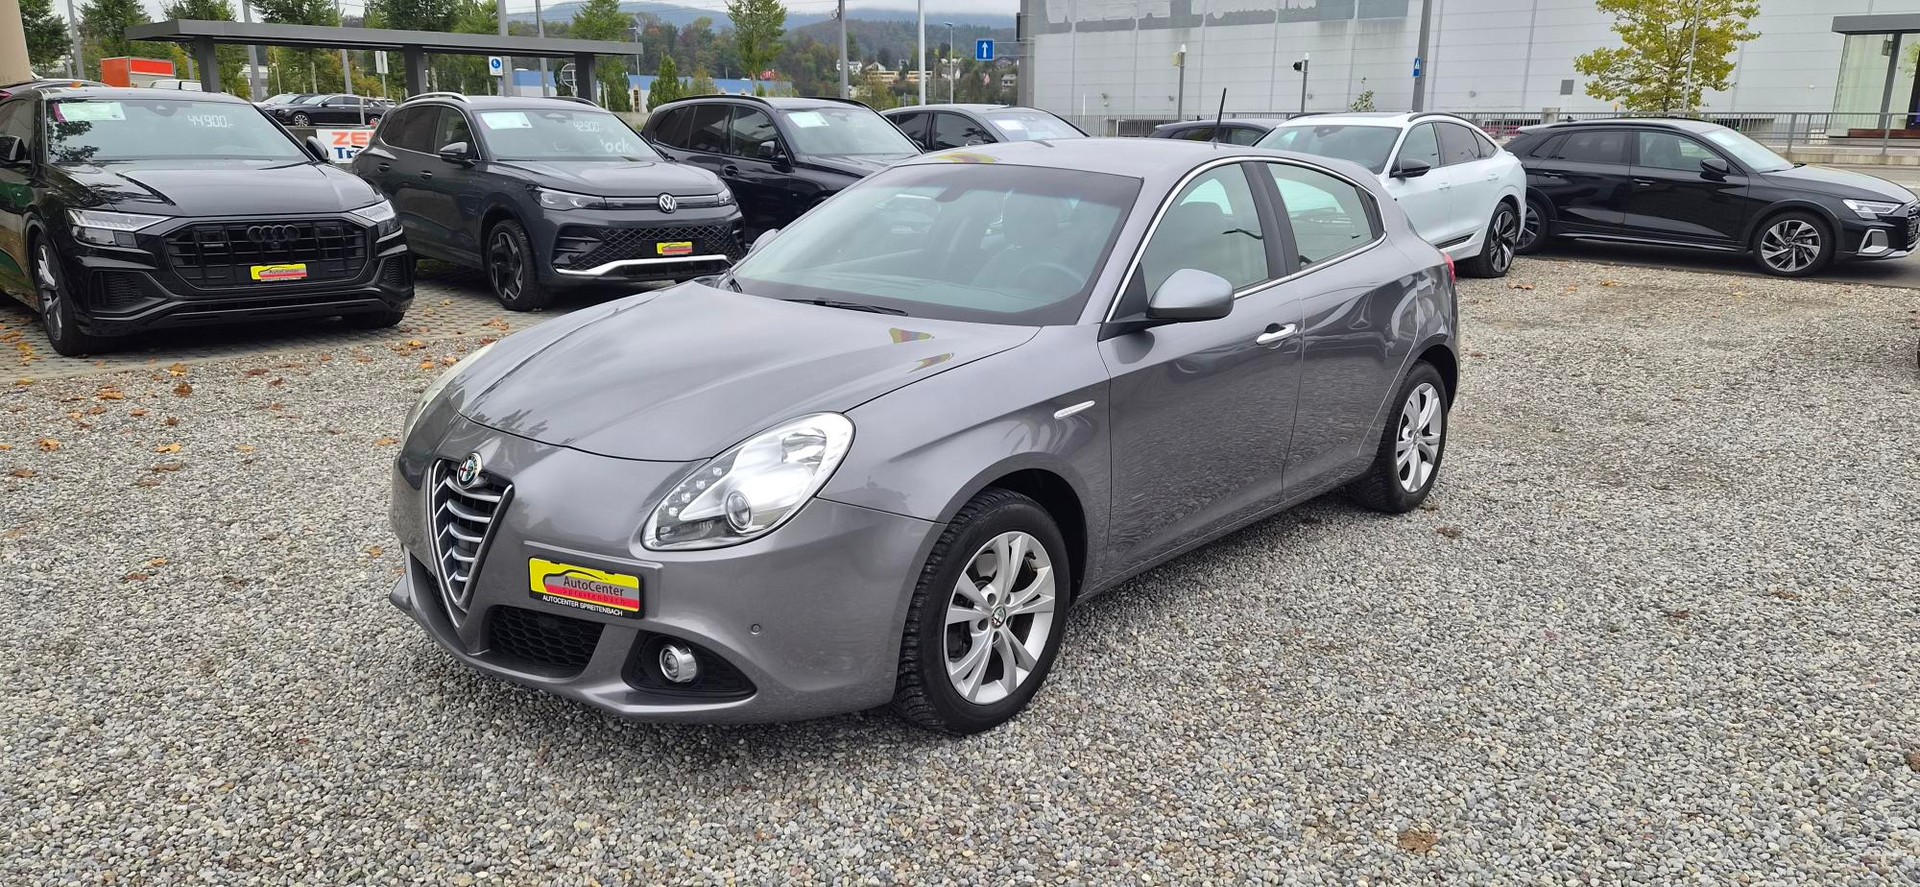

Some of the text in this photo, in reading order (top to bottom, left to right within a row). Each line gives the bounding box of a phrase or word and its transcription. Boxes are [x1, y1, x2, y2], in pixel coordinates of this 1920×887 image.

[331, 131, 374, 146] ZE
[563, 576, 625, 597] AutoCenter
[542, 594, 623, 616] AUTOCENTER SPREITENBACH
